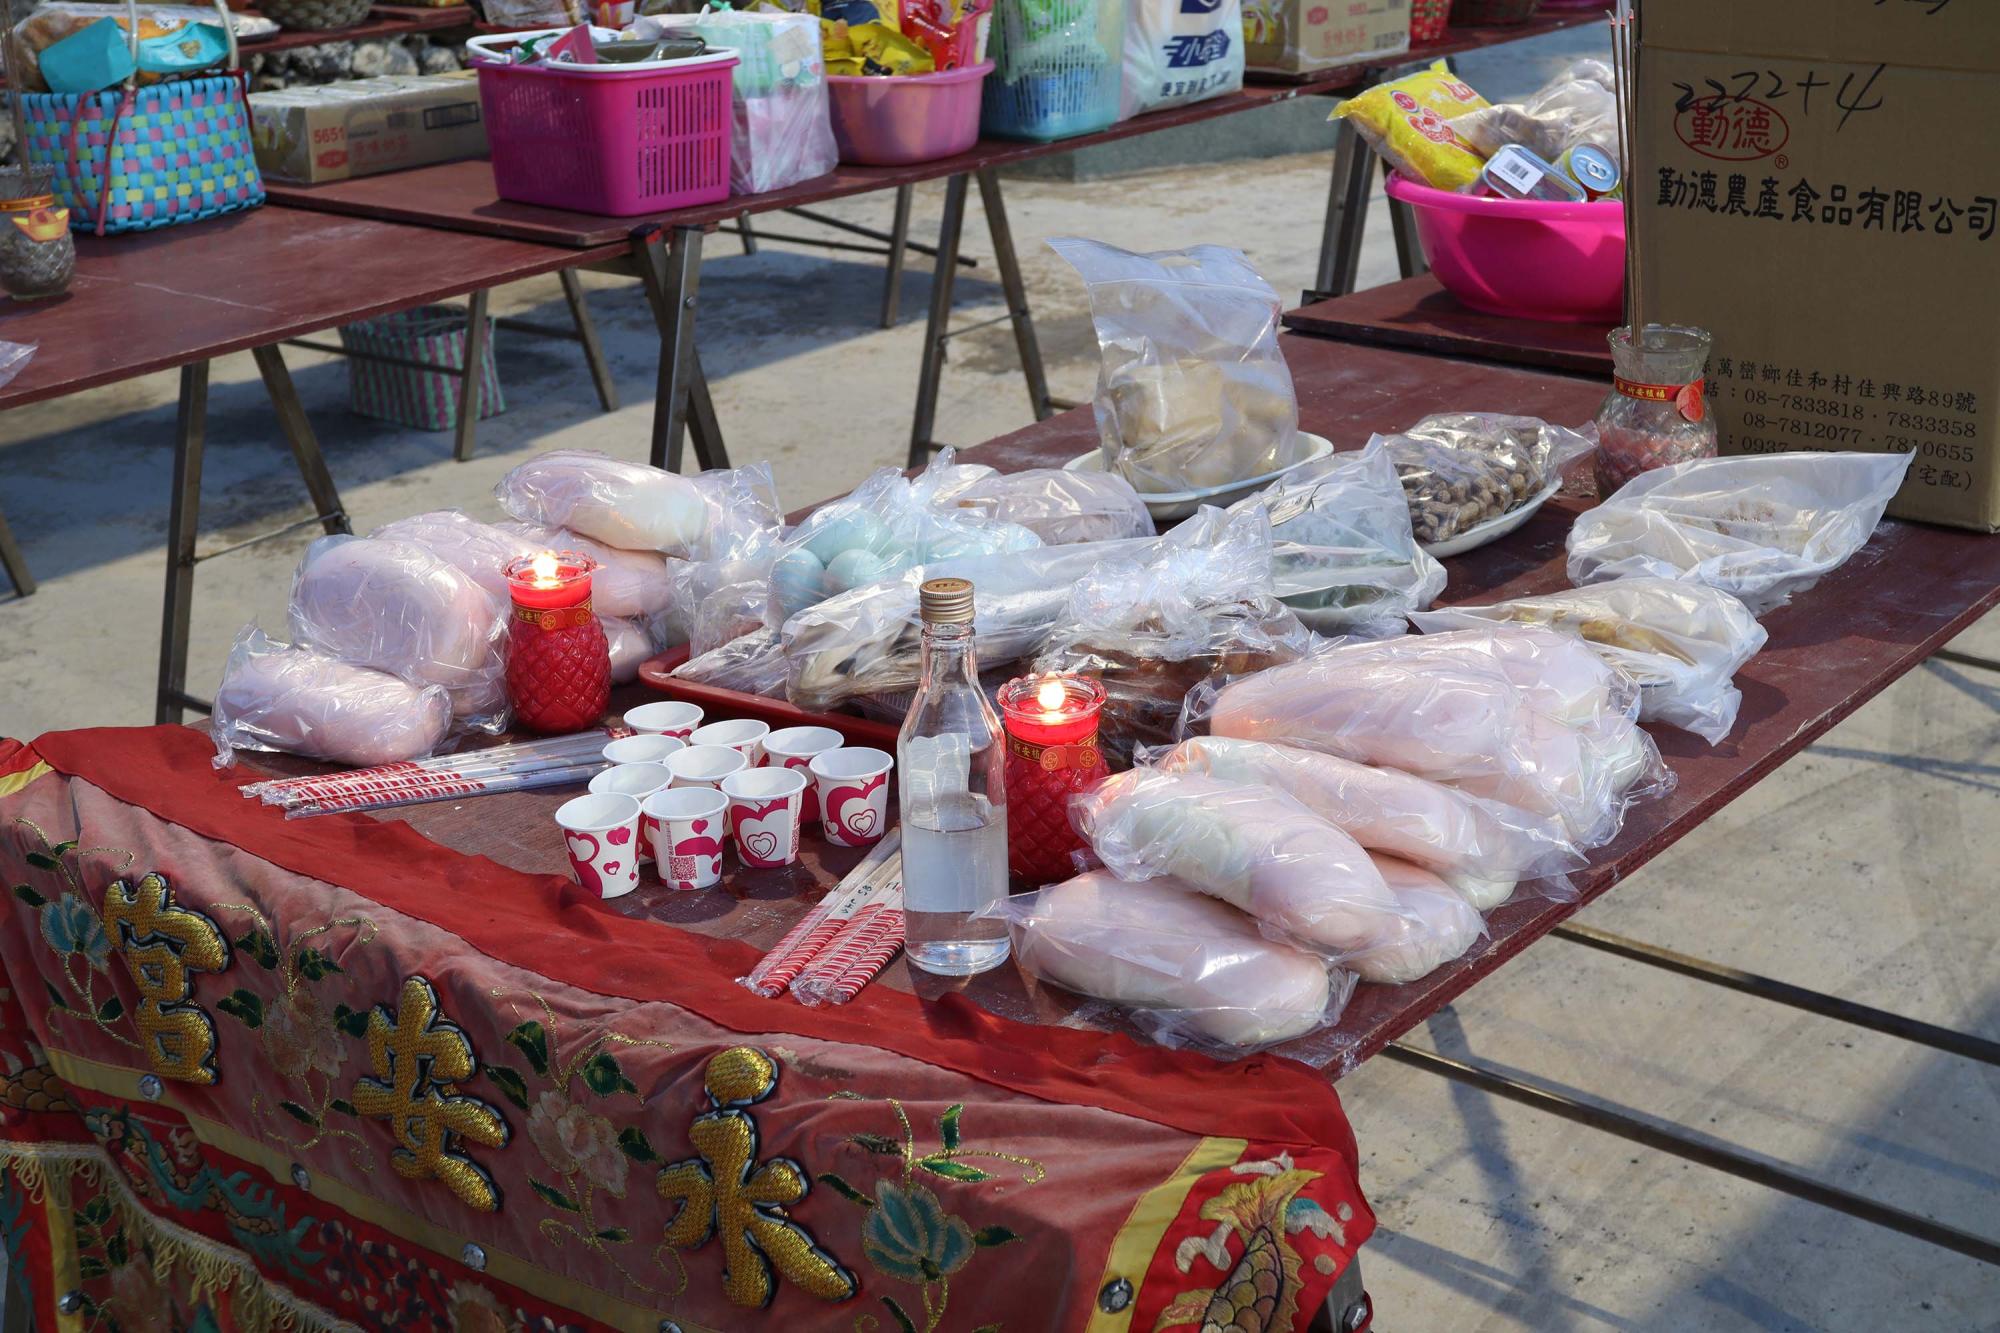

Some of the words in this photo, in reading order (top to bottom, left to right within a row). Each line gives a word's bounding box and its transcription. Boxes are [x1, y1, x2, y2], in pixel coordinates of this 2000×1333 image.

[1689, 100, 1772, 154] 勤德
[1656, 166, 1998, 240] 勤德農產食品有限公司
